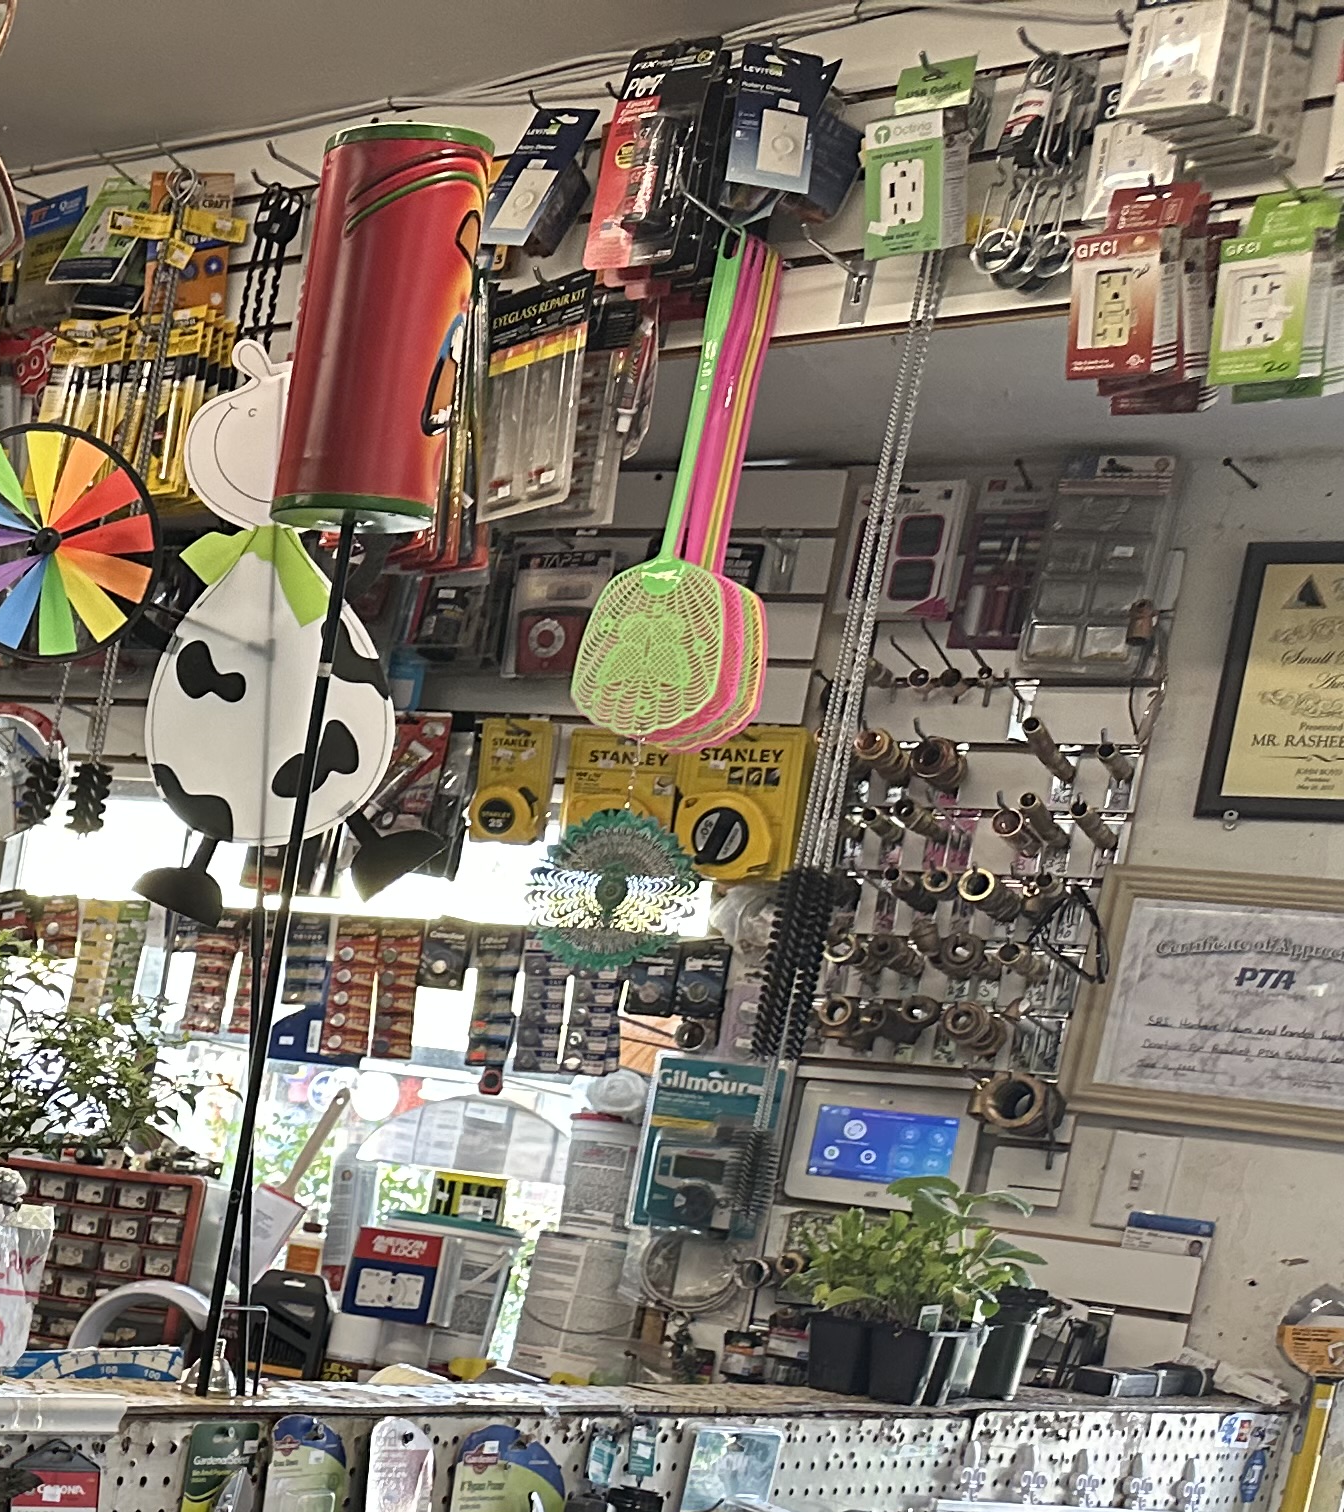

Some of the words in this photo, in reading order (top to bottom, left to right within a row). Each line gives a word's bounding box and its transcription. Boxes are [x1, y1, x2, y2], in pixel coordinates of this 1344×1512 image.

[1075, 239, 1118, 259] GFCI
[1225, 241, 1261, 257] GFCI
[493, 302, 538, 330] EYEGLASS
[538, 292, 570, 316] REPAIR
[570, 287, 588, 307] KIT
[1263, 360, 1291, 374] 20
[491, 736, 537, 748] STANLEY
[1251, 733, 1280, 748] MR.
[588, 749, 669, 767] STANLEY
[699, 748, 785, 764] STANLEY
[1156, 936, 1254, 958] Certificate
[1234, 966, 1297, 990] PTA
[658, 1068, 751, 1096] Gilmour
[371, 1235, 429, 1253] AMERICAN
[388, 1246, 424, 1260] LOCK
